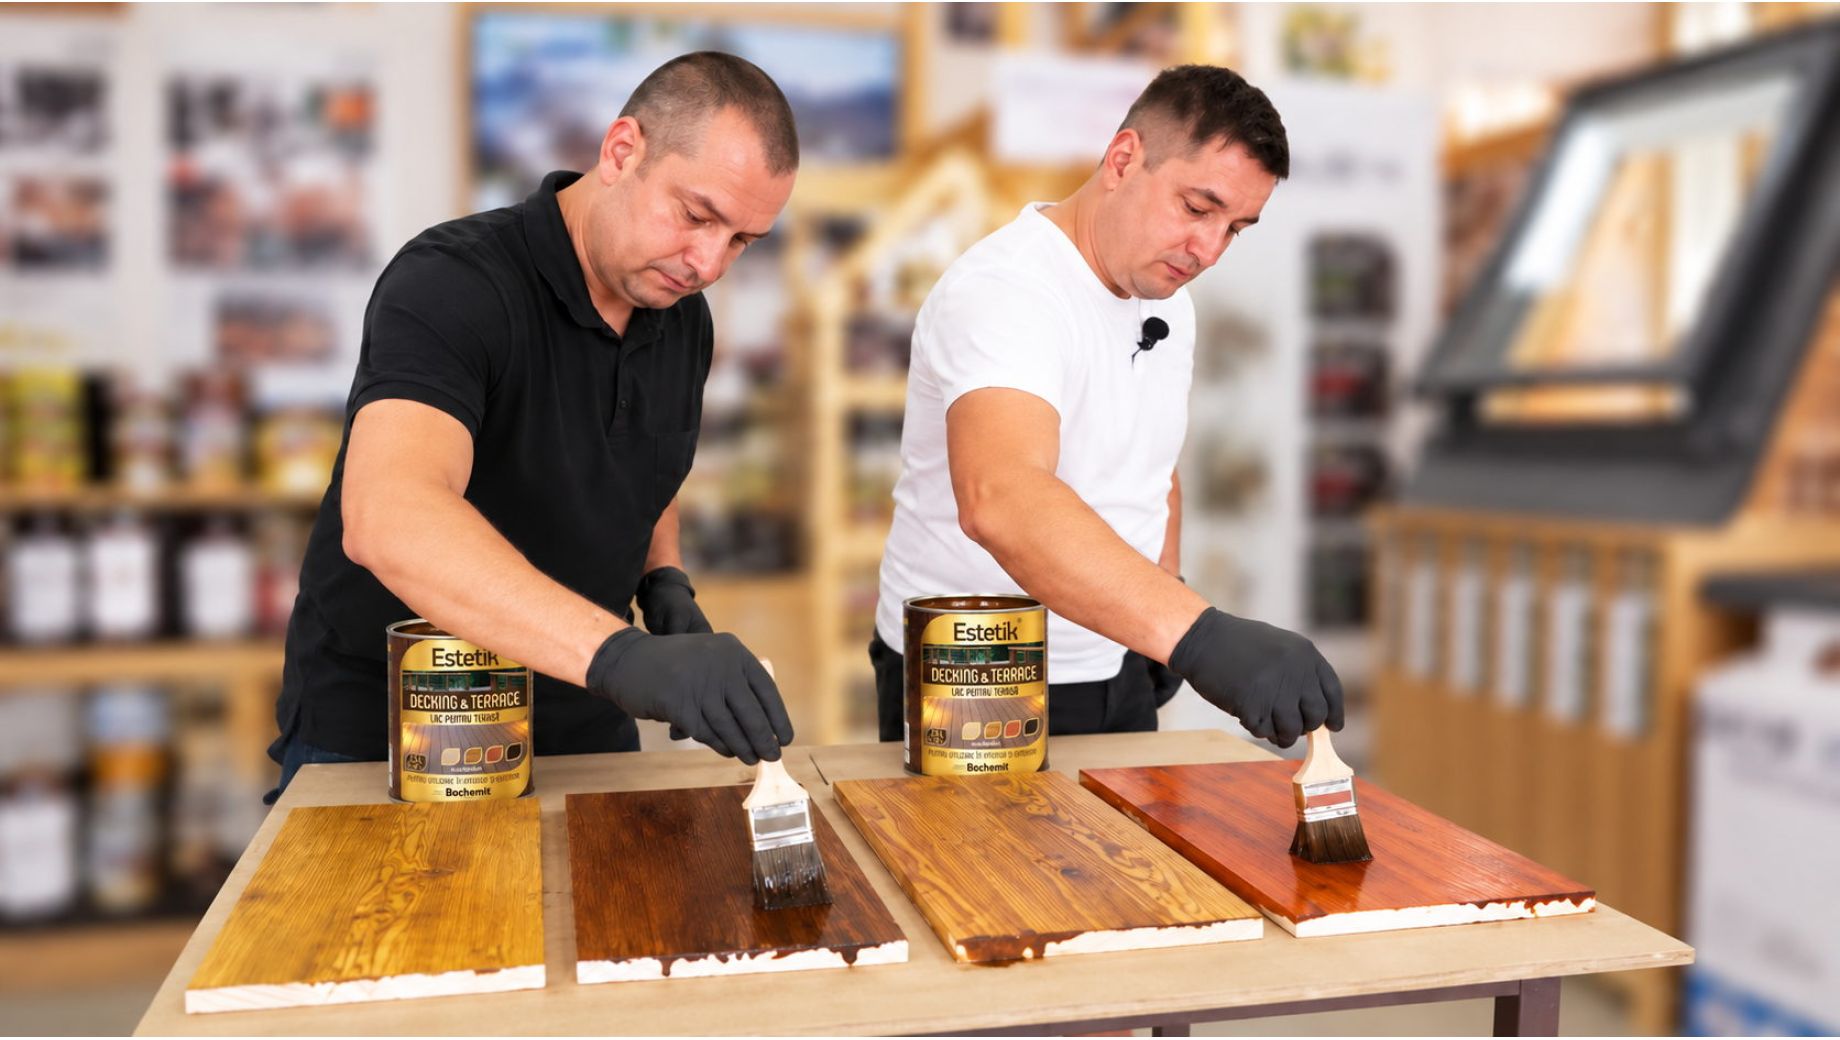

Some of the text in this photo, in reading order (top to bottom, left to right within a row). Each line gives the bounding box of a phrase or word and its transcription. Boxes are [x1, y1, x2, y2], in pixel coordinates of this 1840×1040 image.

[954, 621, 1018, 641] Estetik
[432, 648, 499, 667] Estetik
[931, 665, 1037, 684] DECKING & TERRACE
[951, 687, 964, 697] LAC
[410, 690, 520, 710] DECKING & TERRACE
[430, 713, 443, 724] LAC
[966, 762, 1009, 773] Bochemit
[445, 787, 491, 797] Bochemit
